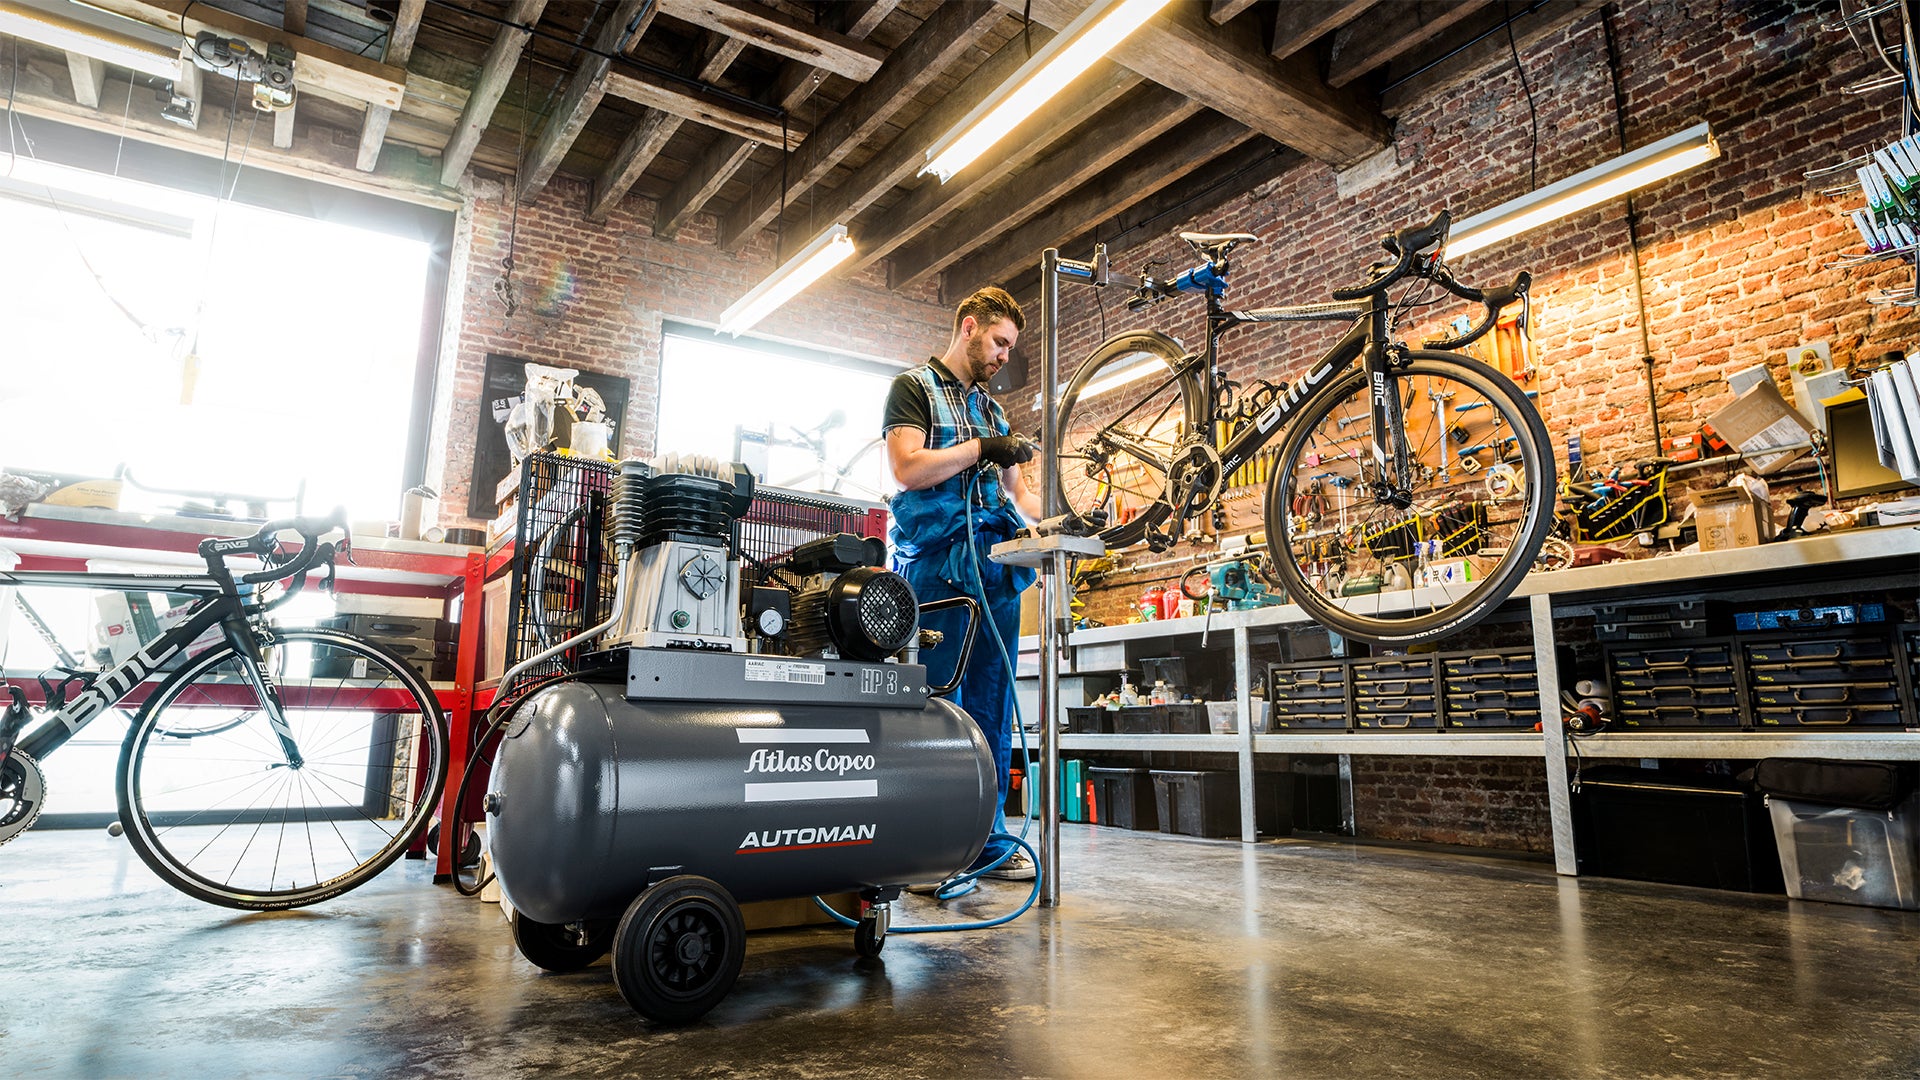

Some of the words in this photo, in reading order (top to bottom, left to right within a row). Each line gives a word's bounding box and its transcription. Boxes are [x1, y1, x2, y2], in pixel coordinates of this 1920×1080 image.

[1256, 363, 1333, 435] BMC
[1373, 371, 1385, 407] BMC
[57, 632, 179, 735] BMC
[257, 661, 278, 696] BMC
[861, 668, 883, 694] HP
[887, 671, 898, 695] 3
[744, 748, 812, 773] Atlas
[814, 748, 876, 776] Copco
[738, 823, 877, 849] AUTOMAN
